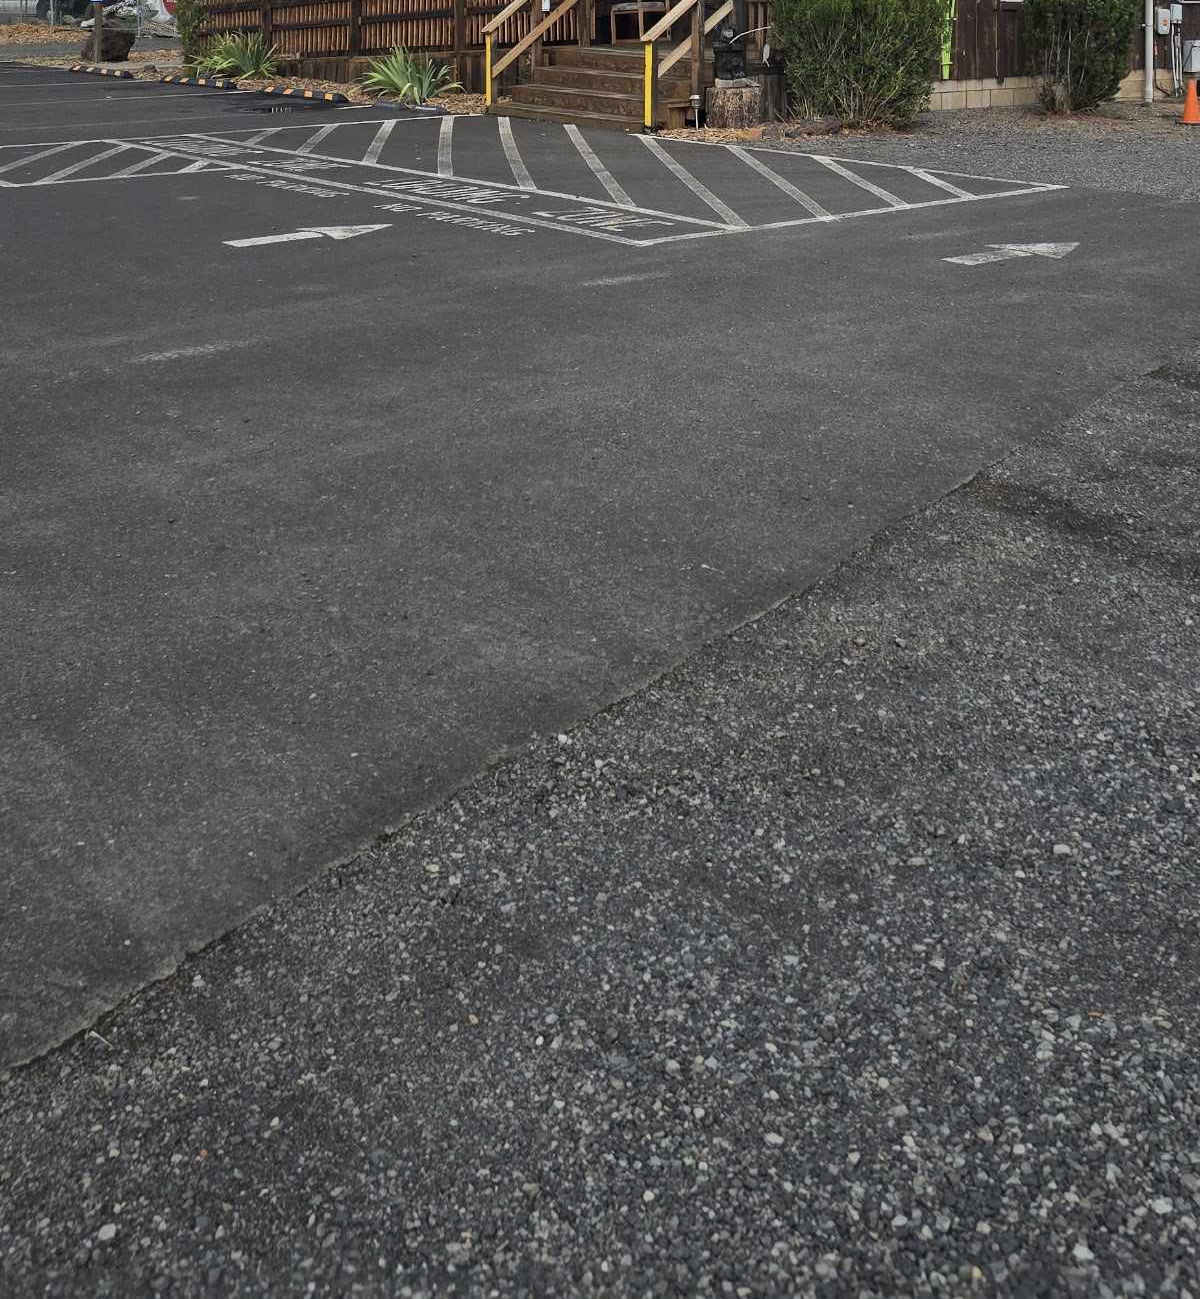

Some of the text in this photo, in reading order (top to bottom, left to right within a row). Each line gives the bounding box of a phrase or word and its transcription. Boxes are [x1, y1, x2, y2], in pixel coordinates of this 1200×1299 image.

[362, 178, 675, 232] LOADING ZONE
[373, 202, 536, 236] NO PARKING
